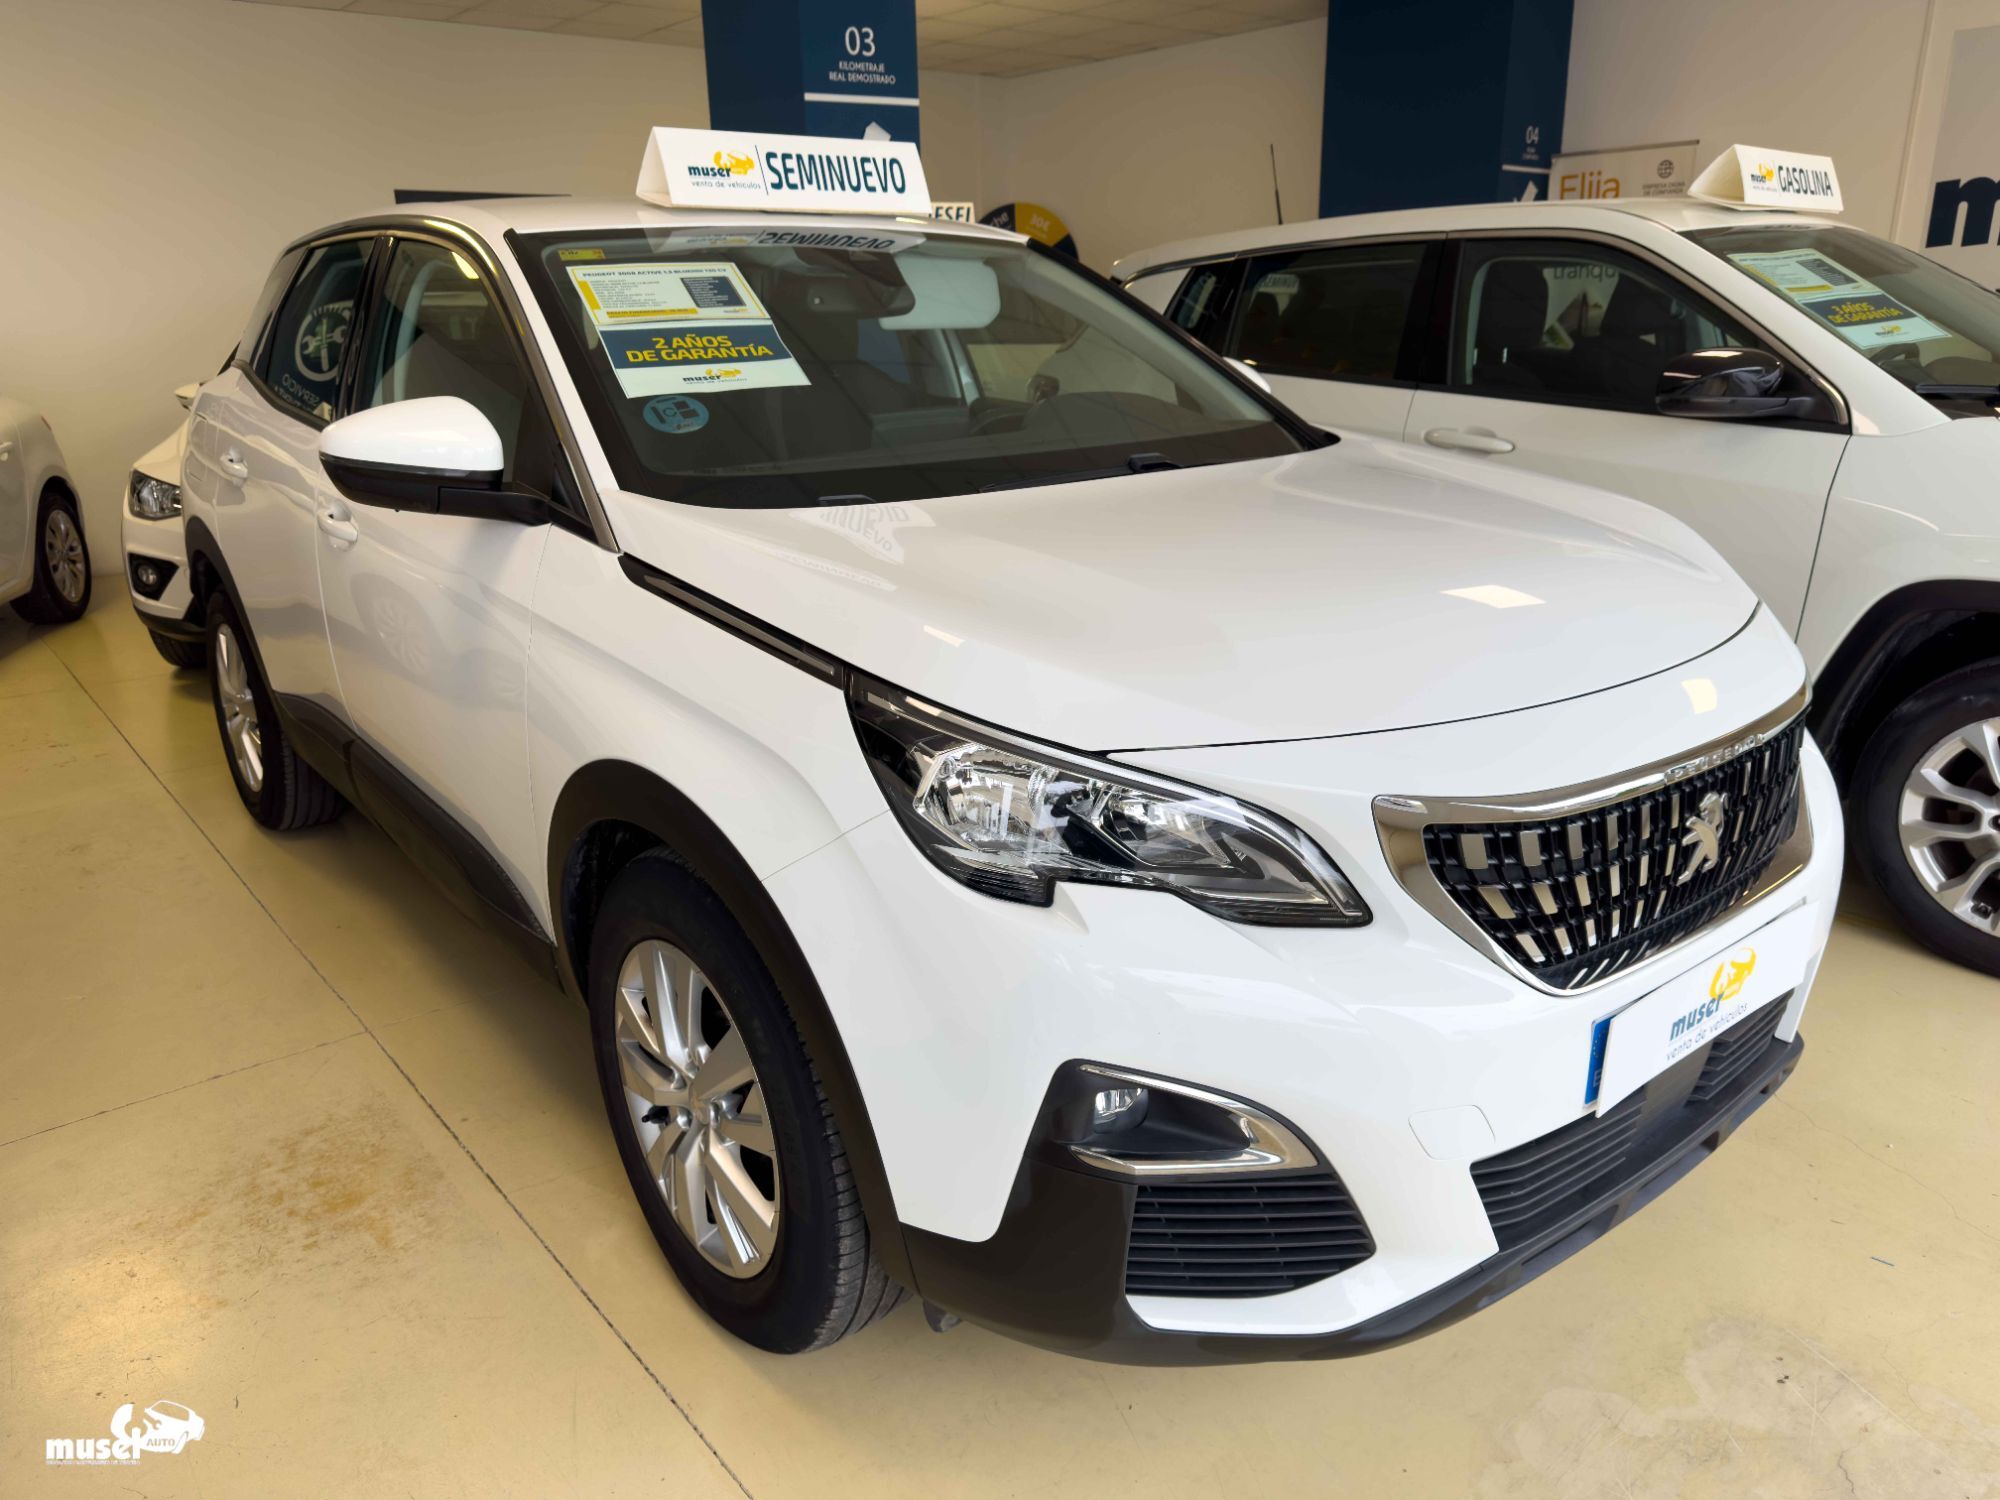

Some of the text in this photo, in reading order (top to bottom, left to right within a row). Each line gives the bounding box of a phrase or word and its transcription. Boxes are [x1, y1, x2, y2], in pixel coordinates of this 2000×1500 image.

[845, 26, 876, 57] 03
[839, 61, 885, 72] KILOMETRAJE
[829, 71, 896, 84] REAL DEMOSTRADO
[1526, 125, 1539, 144] 04
[688, 166, 732, 178] muser
[765, 152, 906, 194] SEMINUEVO
[1777, 165, 1834, 197] GASOLINA
[715, 180, 725, 188] de
[652, 333, 732, 349] 2 AÑOS
[625, 343, 774, 362] DE GARANTÍA
[683, 374, 722, 382] muser
[1670, 992, 1724, 1041] muser
[1666, 1039, 1692, 1061] venta
[1695, 1028, 1706, 1044] de
